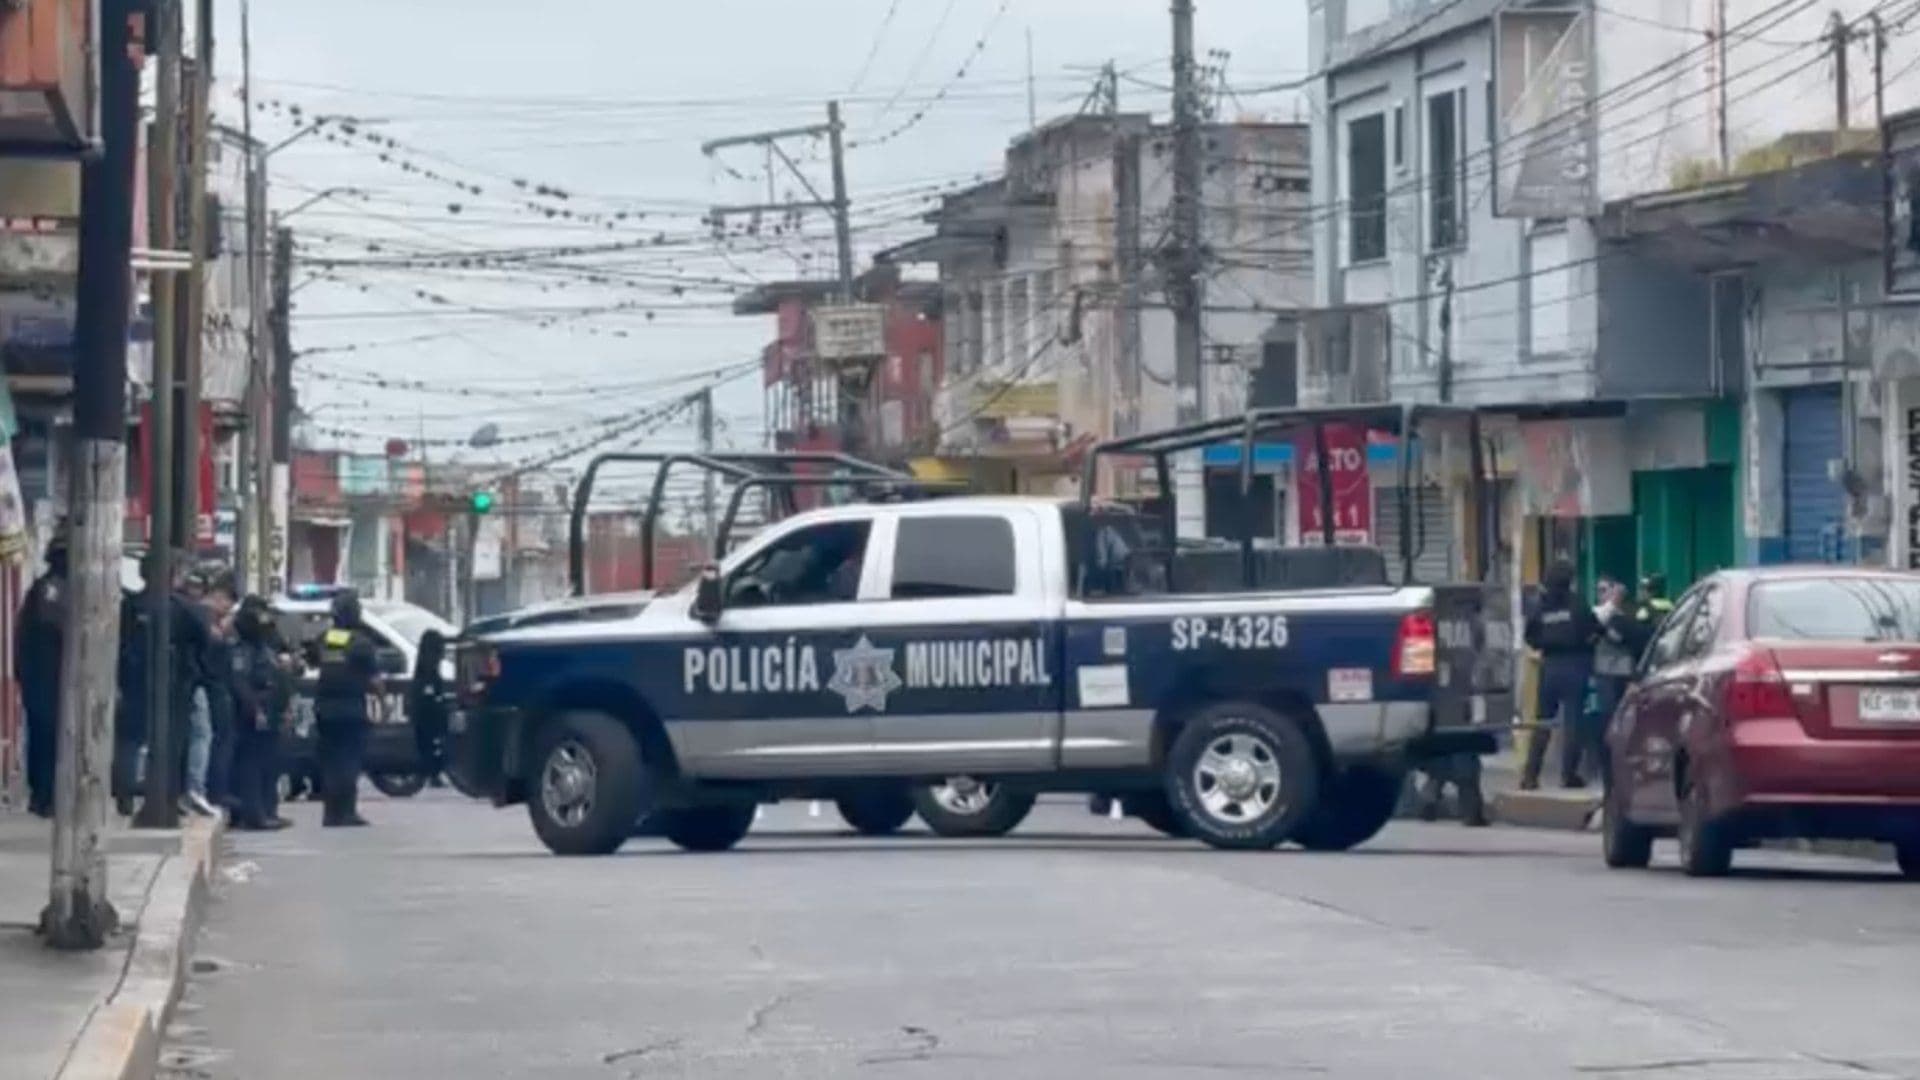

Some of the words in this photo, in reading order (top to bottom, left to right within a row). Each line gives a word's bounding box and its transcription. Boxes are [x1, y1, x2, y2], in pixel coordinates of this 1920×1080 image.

[1171, 616, 1288, 649] SP-4326
[683, 636, 819, 693] POLICÍA
[906, 638, 1051, 687] MUNICIPAL
